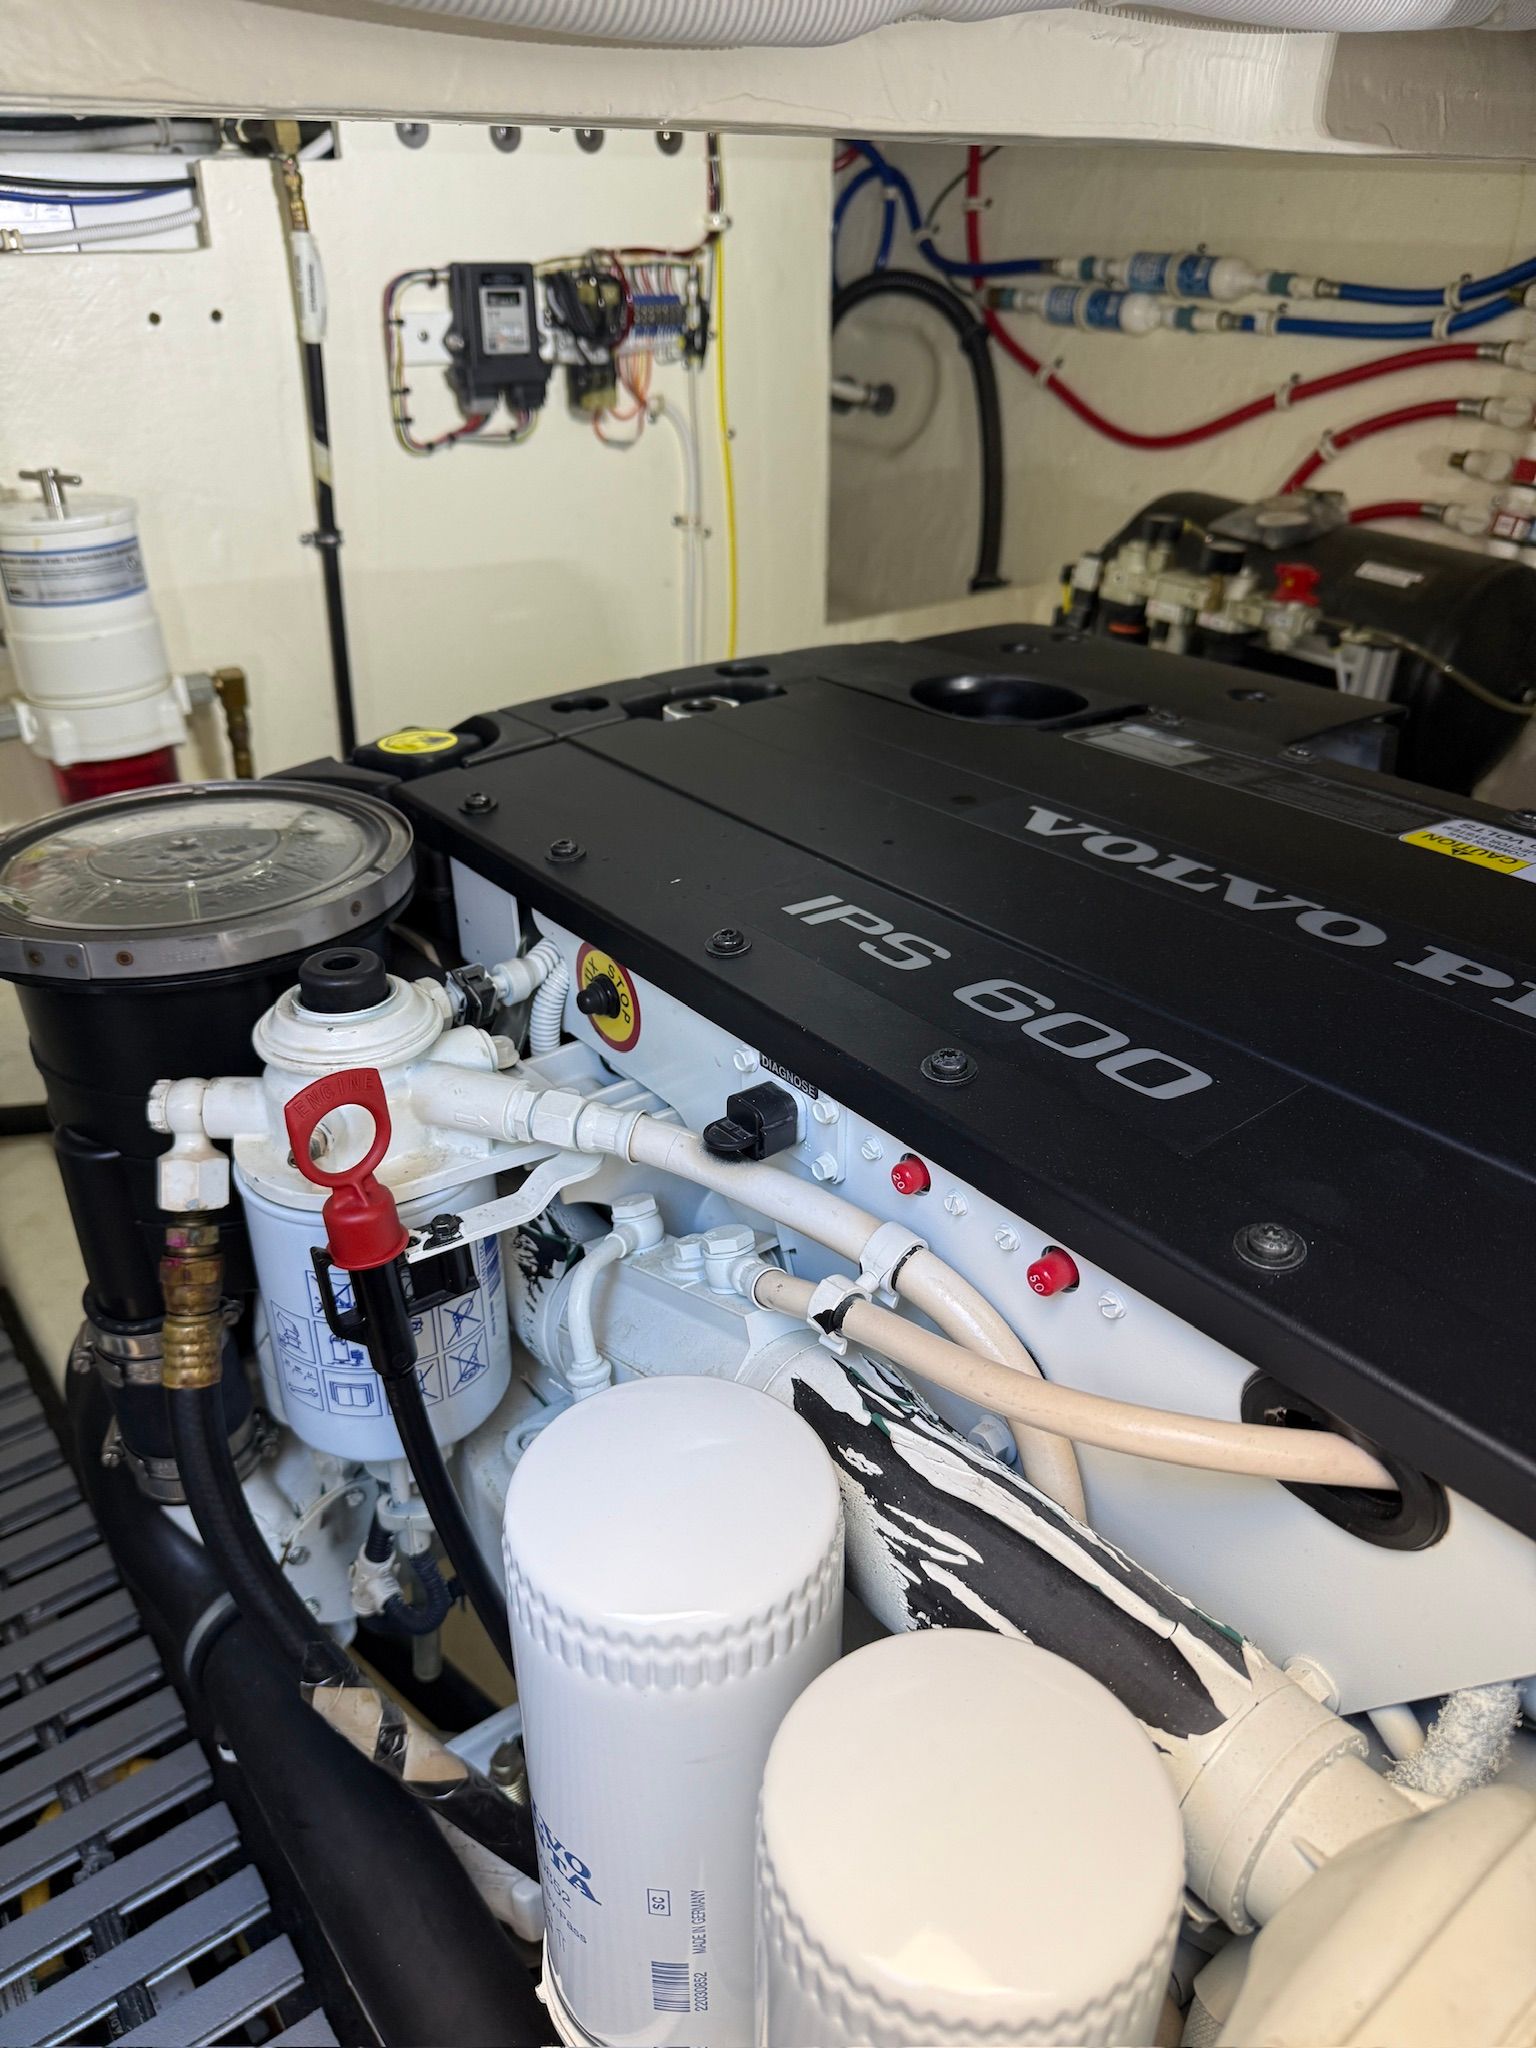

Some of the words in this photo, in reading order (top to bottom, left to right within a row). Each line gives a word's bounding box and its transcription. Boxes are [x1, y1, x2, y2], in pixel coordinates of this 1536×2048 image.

[1422, 832, 1518, 865] CAUTION
[1458, 823, 1523, 845] VOLTS
[1025, 805, 1388, 947] VOLVO
[583, 956, 600, 984] UX
[607, 963, 632, 1025] STOP
[780, 894, 952, 971] IPS
[952, 978, 1213, 1100] 600
[761, 1054, 817, 1099] DIAGNOSE
[292, 1071, 375, 1119] ENGINE
[892, 1172, 906, 1190] 20
[1029, 1274, 1045, 1292] 50
[651, 1895, 666, 1911] SC
[690, 1889, 706, 1925] GERMANY
[691, 1933, 707, 1955] MADE
[693, 1971, 709, 2012] 22030852
